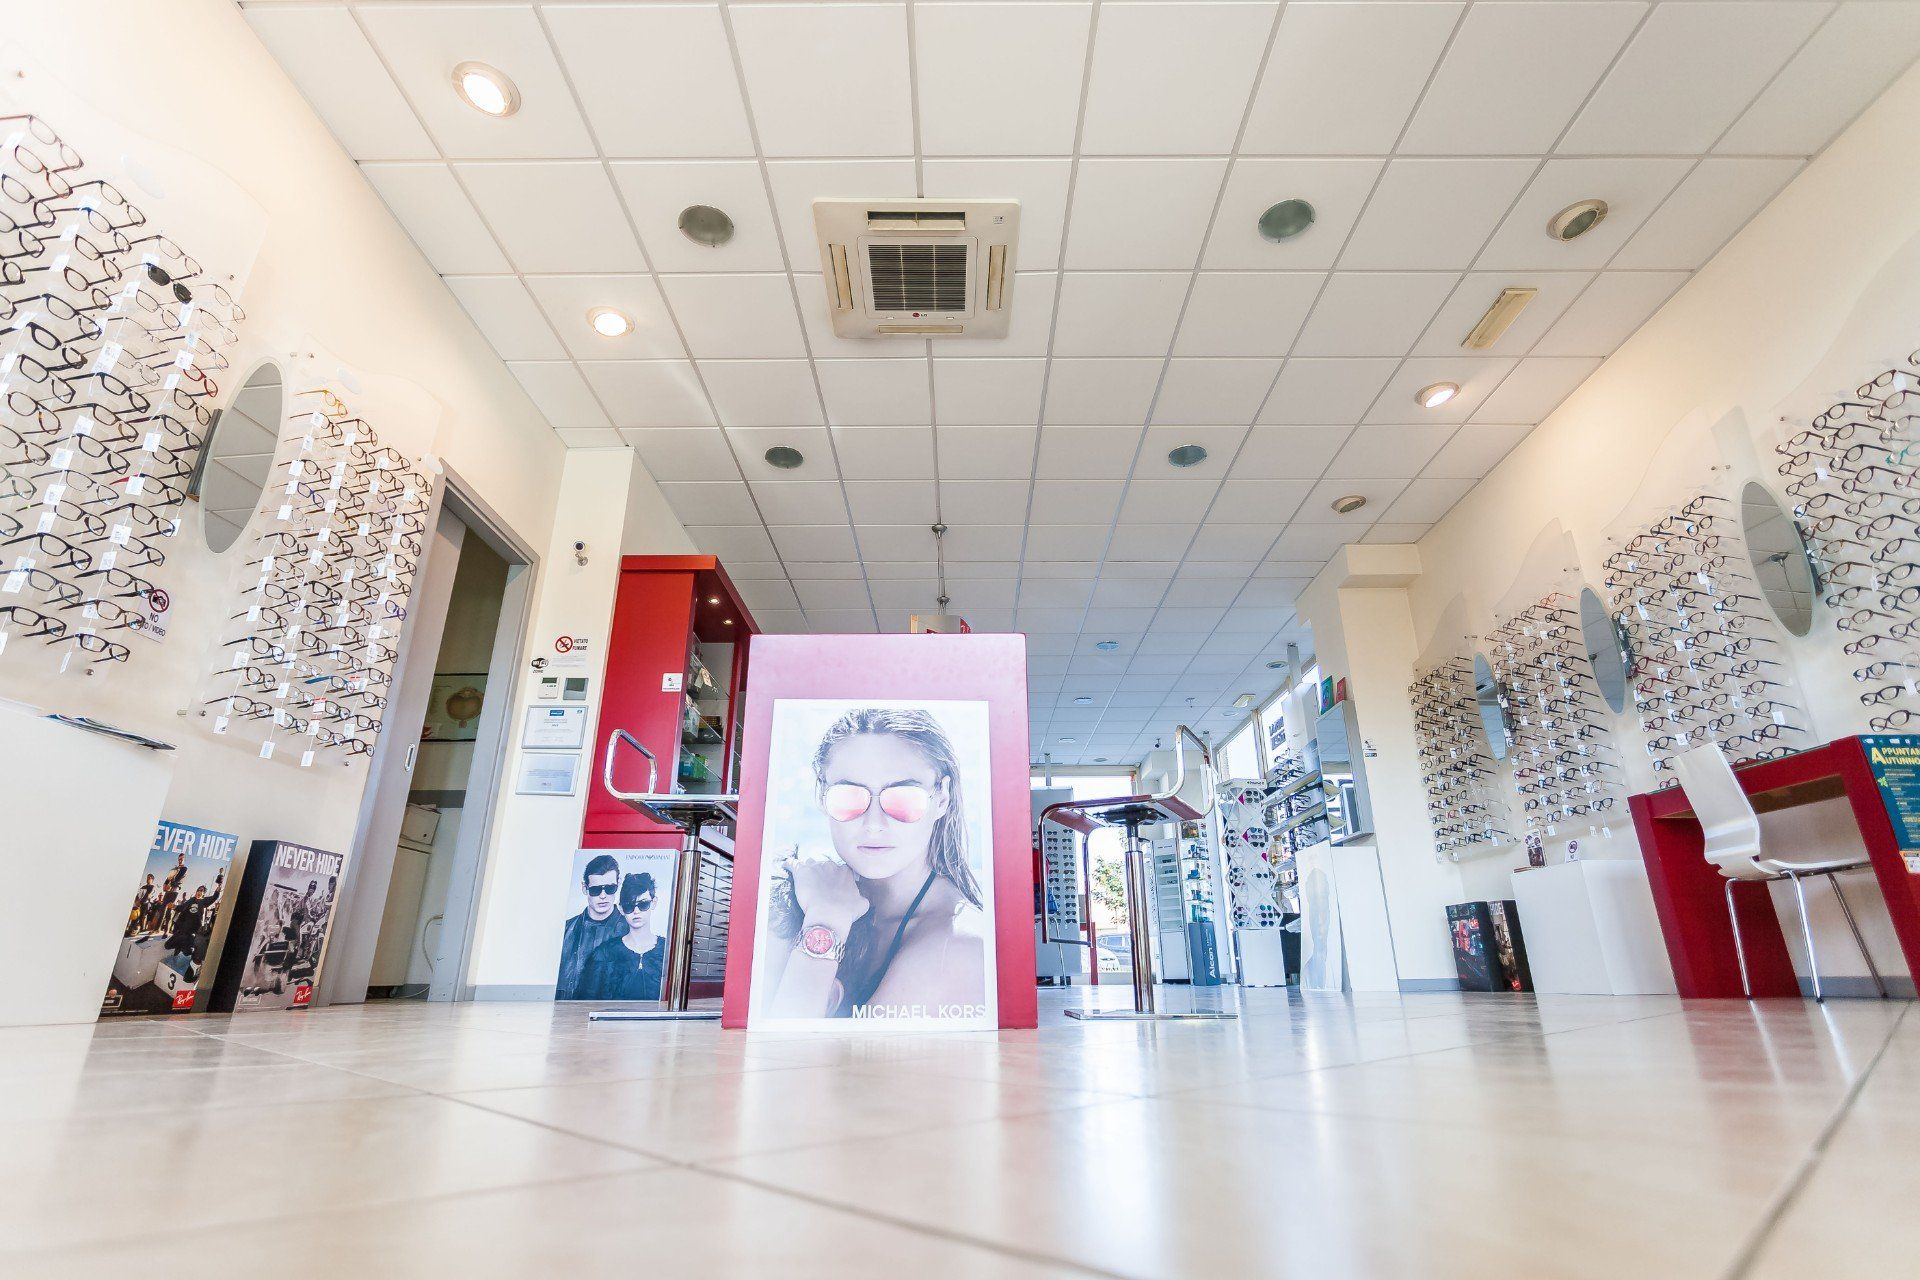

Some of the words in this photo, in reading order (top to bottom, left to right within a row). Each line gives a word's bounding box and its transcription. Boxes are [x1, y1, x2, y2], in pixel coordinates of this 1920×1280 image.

[151, 825, 196, 855] EVER
[197, 833, 235, 862] HIDE
[274, 844, 314, 872] NEVER
[315, 852, 343, 877] HIDE
[167, 973, 177, 990] 3
[852, 1004, 932, 1019] MICHAEL
[938, 1004, 986, 1019] KORS
